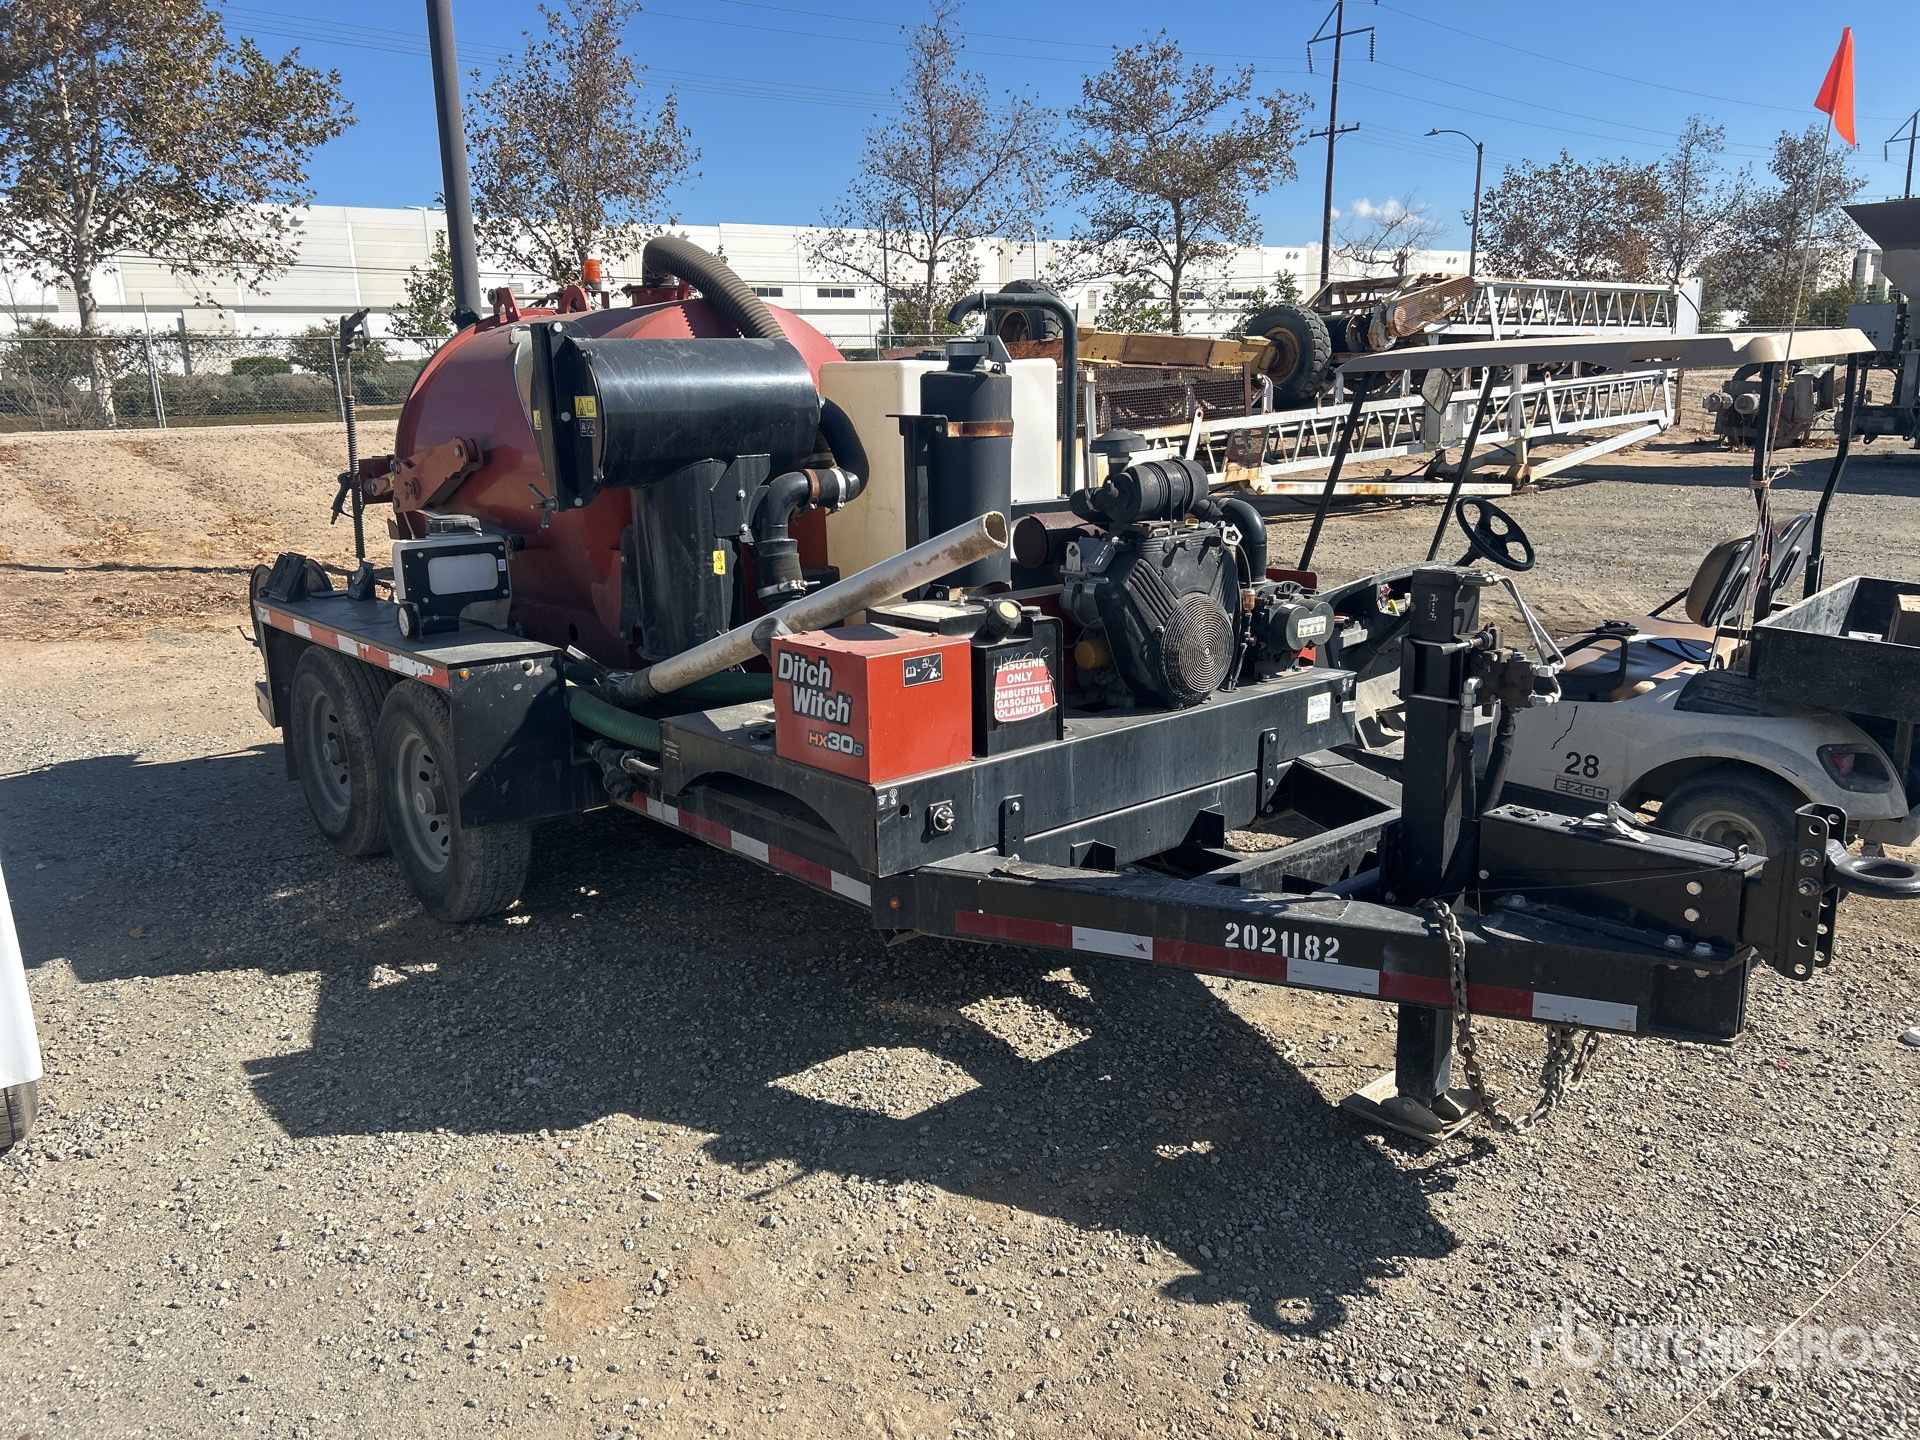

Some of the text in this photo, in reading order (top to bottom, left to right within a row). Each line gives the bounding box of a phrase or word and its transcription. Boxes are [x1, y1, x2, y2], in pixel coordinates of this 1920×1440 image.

[778, 652, 831, 688] Ditch
[999, 658, 1045, 671] ASOLINE
[1007, 671, 1033, 684] ONLY
[995, 685, 1051, 700] OMBUSTIBLE
[997, 695, 1041, 710] GASOLINA
[793, 686, 849, 723] Witch
[808, 731, 863, 756] HX30G
[1564, 752, 1599, 778] 28
[1554, 779, 1609, 800] EZGO
